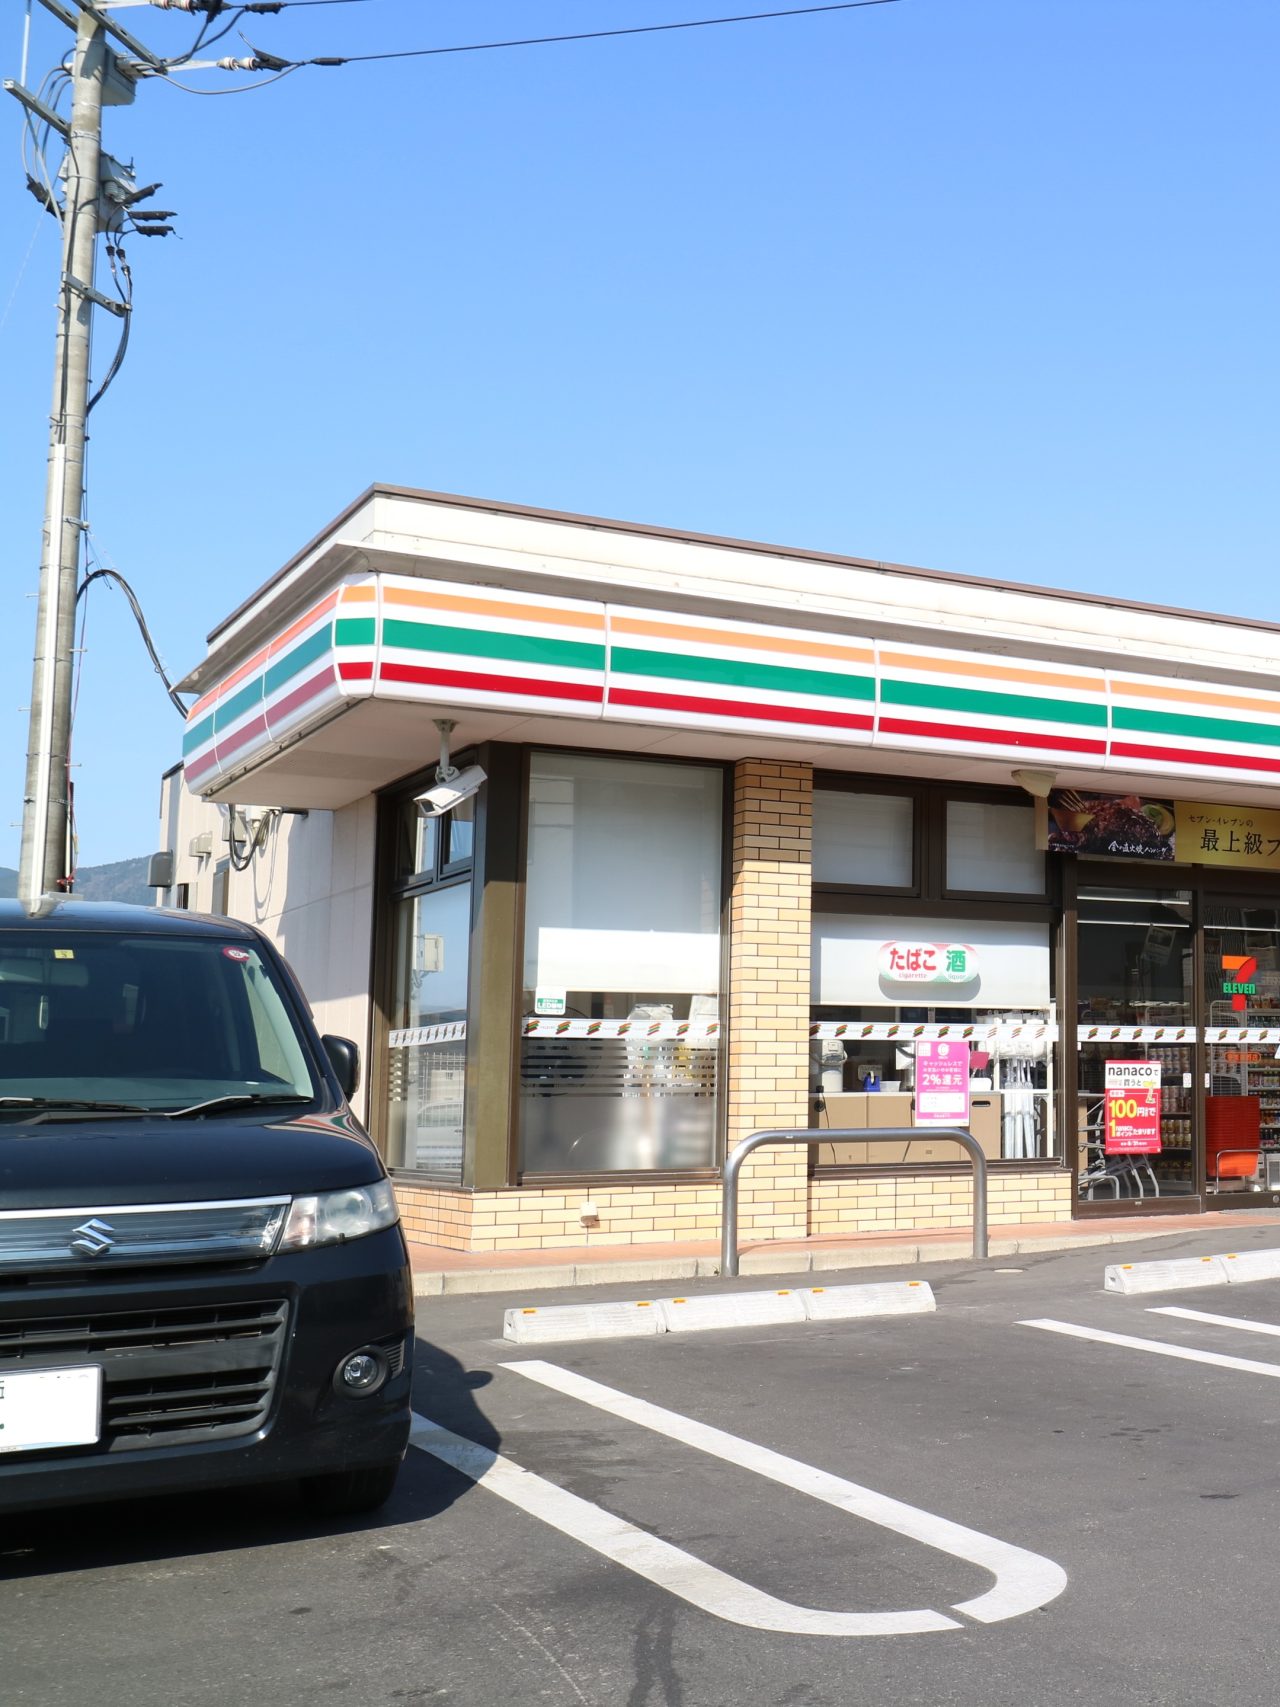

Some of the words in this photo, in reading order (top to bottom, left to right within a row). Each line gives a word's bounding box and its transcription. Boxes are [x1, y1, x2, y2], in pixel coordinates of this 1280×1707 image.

[889, 947, 937, 972] たばこ
[945, 949, 967, 973] 酒
[898, 972, 928, 980] cigarette
[921, 1074, 963, 1086] 2%還元
